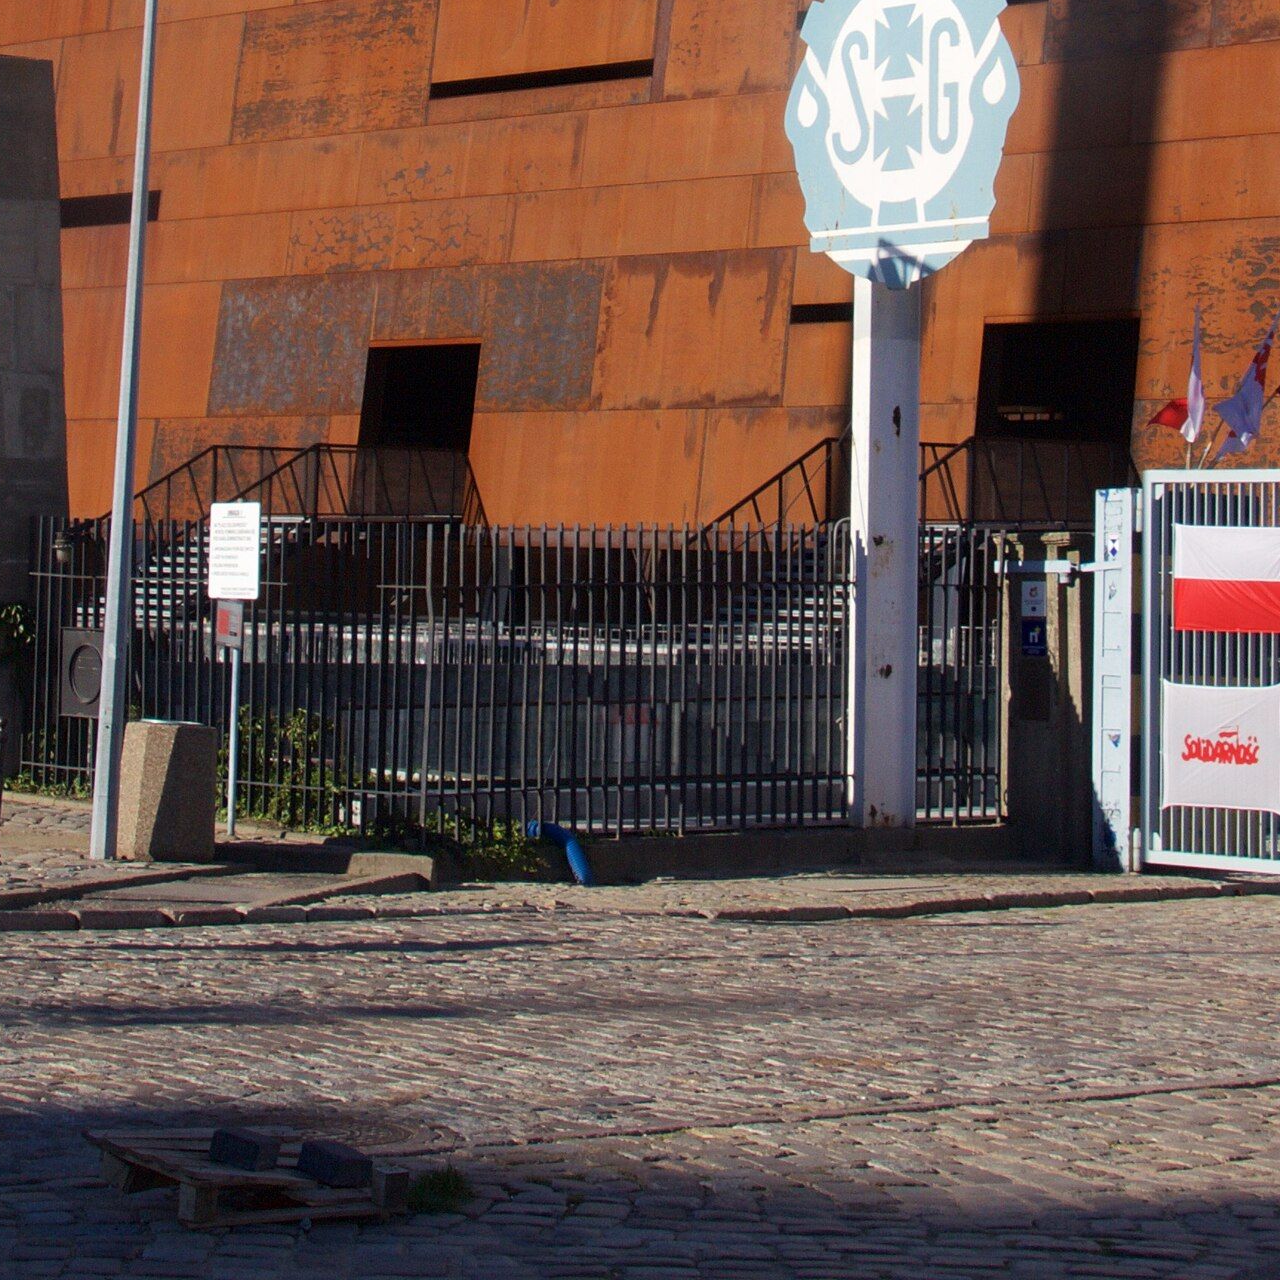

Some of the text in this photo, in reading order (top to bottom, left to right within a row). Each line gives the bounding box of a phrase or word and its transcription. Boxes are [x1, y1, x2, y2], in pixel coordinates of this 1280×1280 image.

[831, 16, 961, 166] S G
[1181, 731, 1260, 765] SOLIDARNOŚĆ
